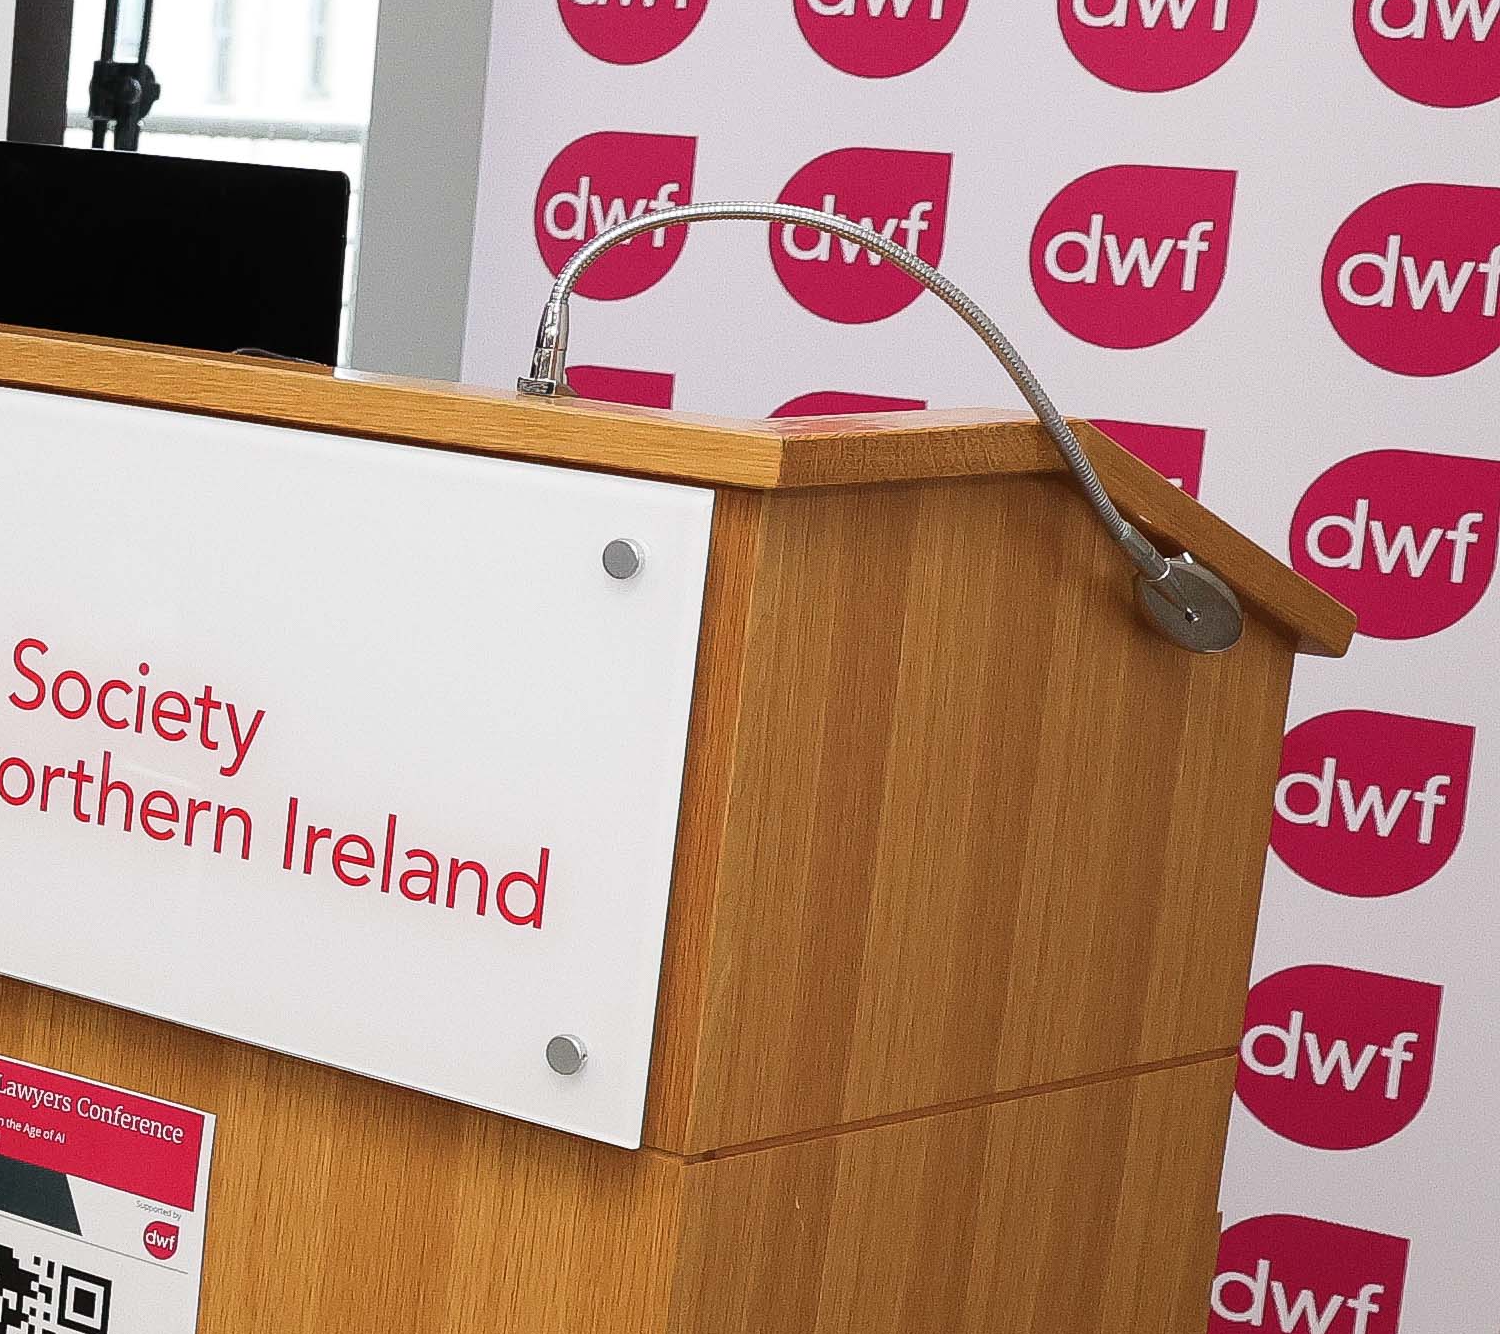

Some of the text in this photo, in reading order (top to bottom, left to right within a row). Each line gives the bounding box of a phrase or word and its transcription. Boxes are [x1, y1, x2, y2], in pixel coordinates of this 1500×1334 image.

[1043, 213, 1214, 292] dwf
[1304, 498, 1484, 584] dwf
[8, 638, 266, 778] Society
[1274, 755, 1451, 845] dwf
[283, 797, 550, 930] Ireland
[1239, 1009, 1420, 1100] dwf
[6, 1117, 21, 1131] the
[22, 1122, 41, 1139] Age
[43, 1128, 55, 1141] of
[54, 1131, 66, 1144] AI
[77, 1097, 184, 1144] Conference
[145, 1229, 176, 1251] dwf
